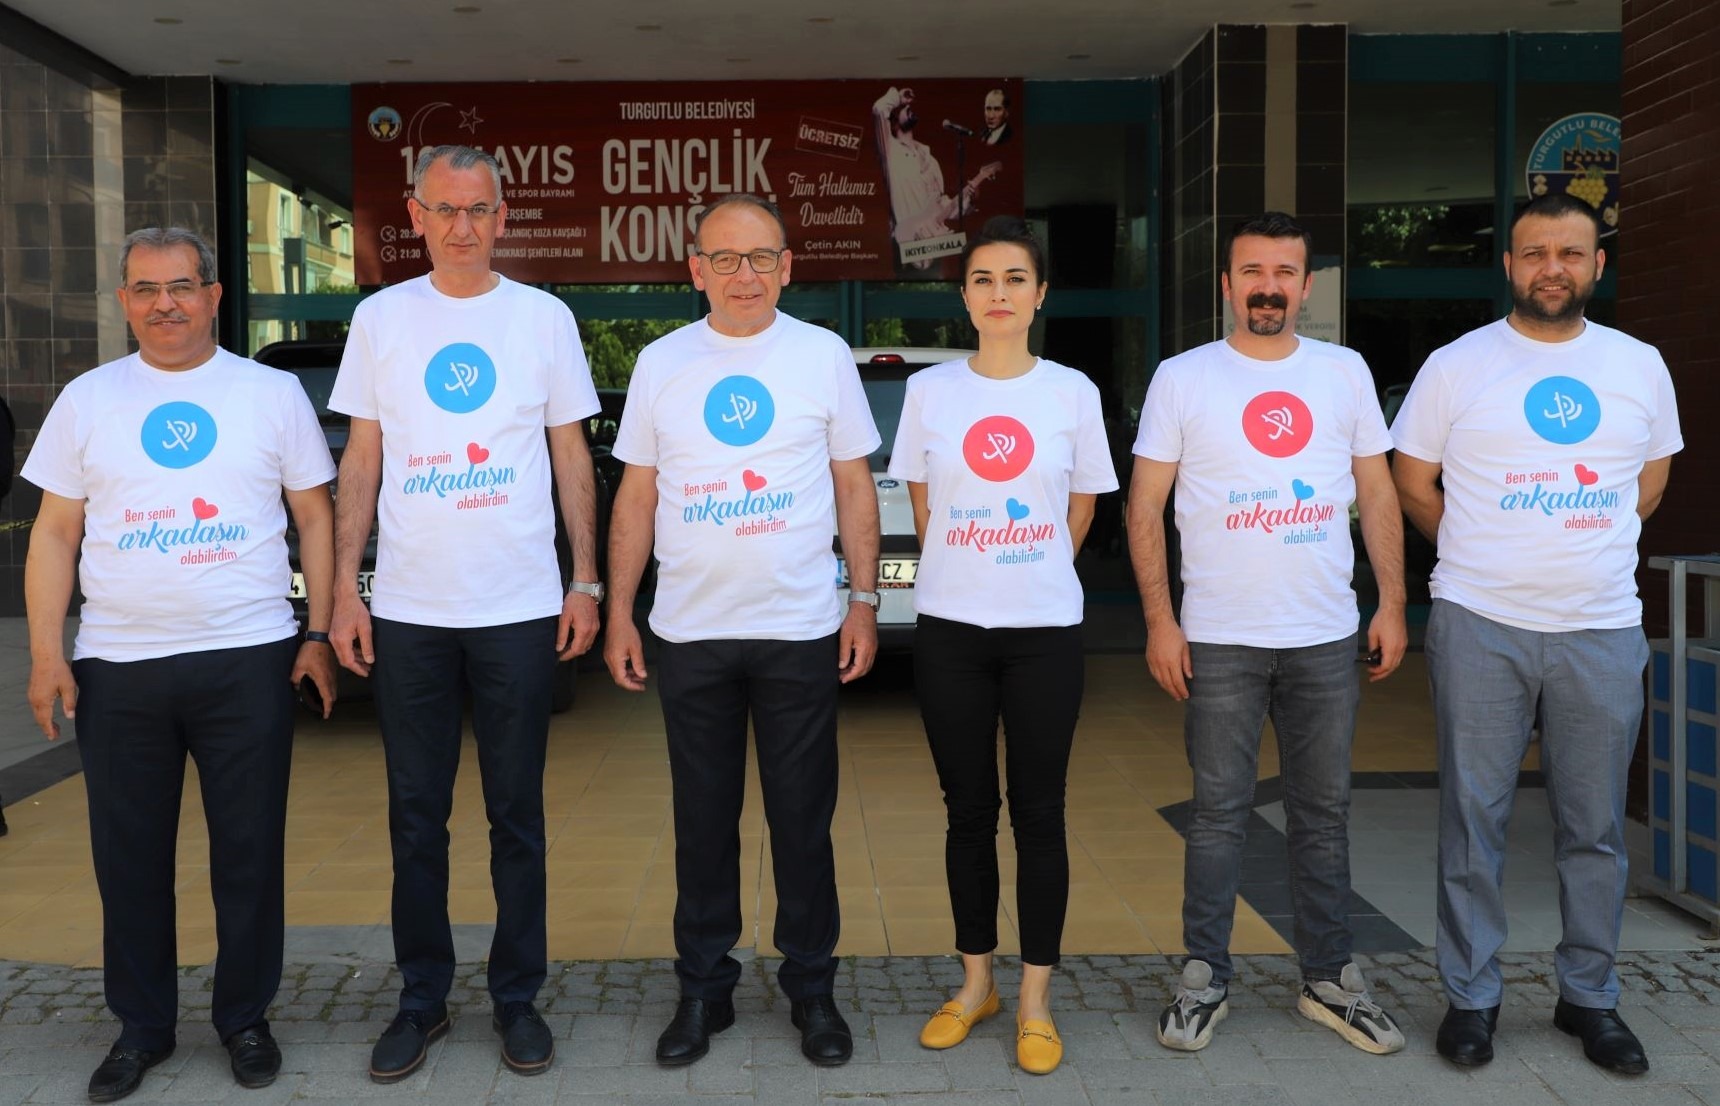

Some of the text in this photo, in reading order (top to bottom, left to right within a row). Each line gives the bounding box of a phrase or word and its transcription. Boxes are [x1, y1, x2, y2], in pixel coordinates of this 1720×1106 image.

[620, 99, 755, 120] TURGUTLU BELEDİYESİ
[799, 124, 860, 150] ÜCRETSİZ
[1533, 119, 1586, 170] TURGUTLU
[476, 145, 575, 185] AYIS
[602, 128, 773, 203] GENÇLİK
[506, 190, 516, 198] VE
[518, 189, 539, 198] SPOR
[540, 189, 575, 198] BAYRAMI
[788, 172, 815, 197] Tüm
[505, 208, 543, 221] ERŞEMBE
[400, 248, 421, 259] 21:30
[491, 246, 527, 258] EMOKRASİ
[805, 240, 861, 251] Çetin AKIN
[408, 451, 452, 468] Ben senin
[403, 464, 517, 498] arkadaşın
[1505, 469, 1559, 485] Ben senin
[684, 479, 727, 497] Ben senin
[1229, 487, 1278, 504] Ben senin
[456, 491, 509, 510] olabilirdim
[683, 490, 795, 526] arkadaşın
[1500, 483, 1619, 517] arkadaşın
[125, 506, 176, 522] Ben senin
[950, 505, 991, 520] Ben senin
[1226, 499, 1336, 534] arkadaşın
[1564, 514, 1613, 529] olabilirdim
[735, 517, 787, 536] olabilirdim
[946, 519, 1057, 552] arkadaşın
[118, 519, 250, 554] arkadaşın
[180, 547, 238, 565] olabilirdim
[995, 548, 1045, 565] olabilirdim
